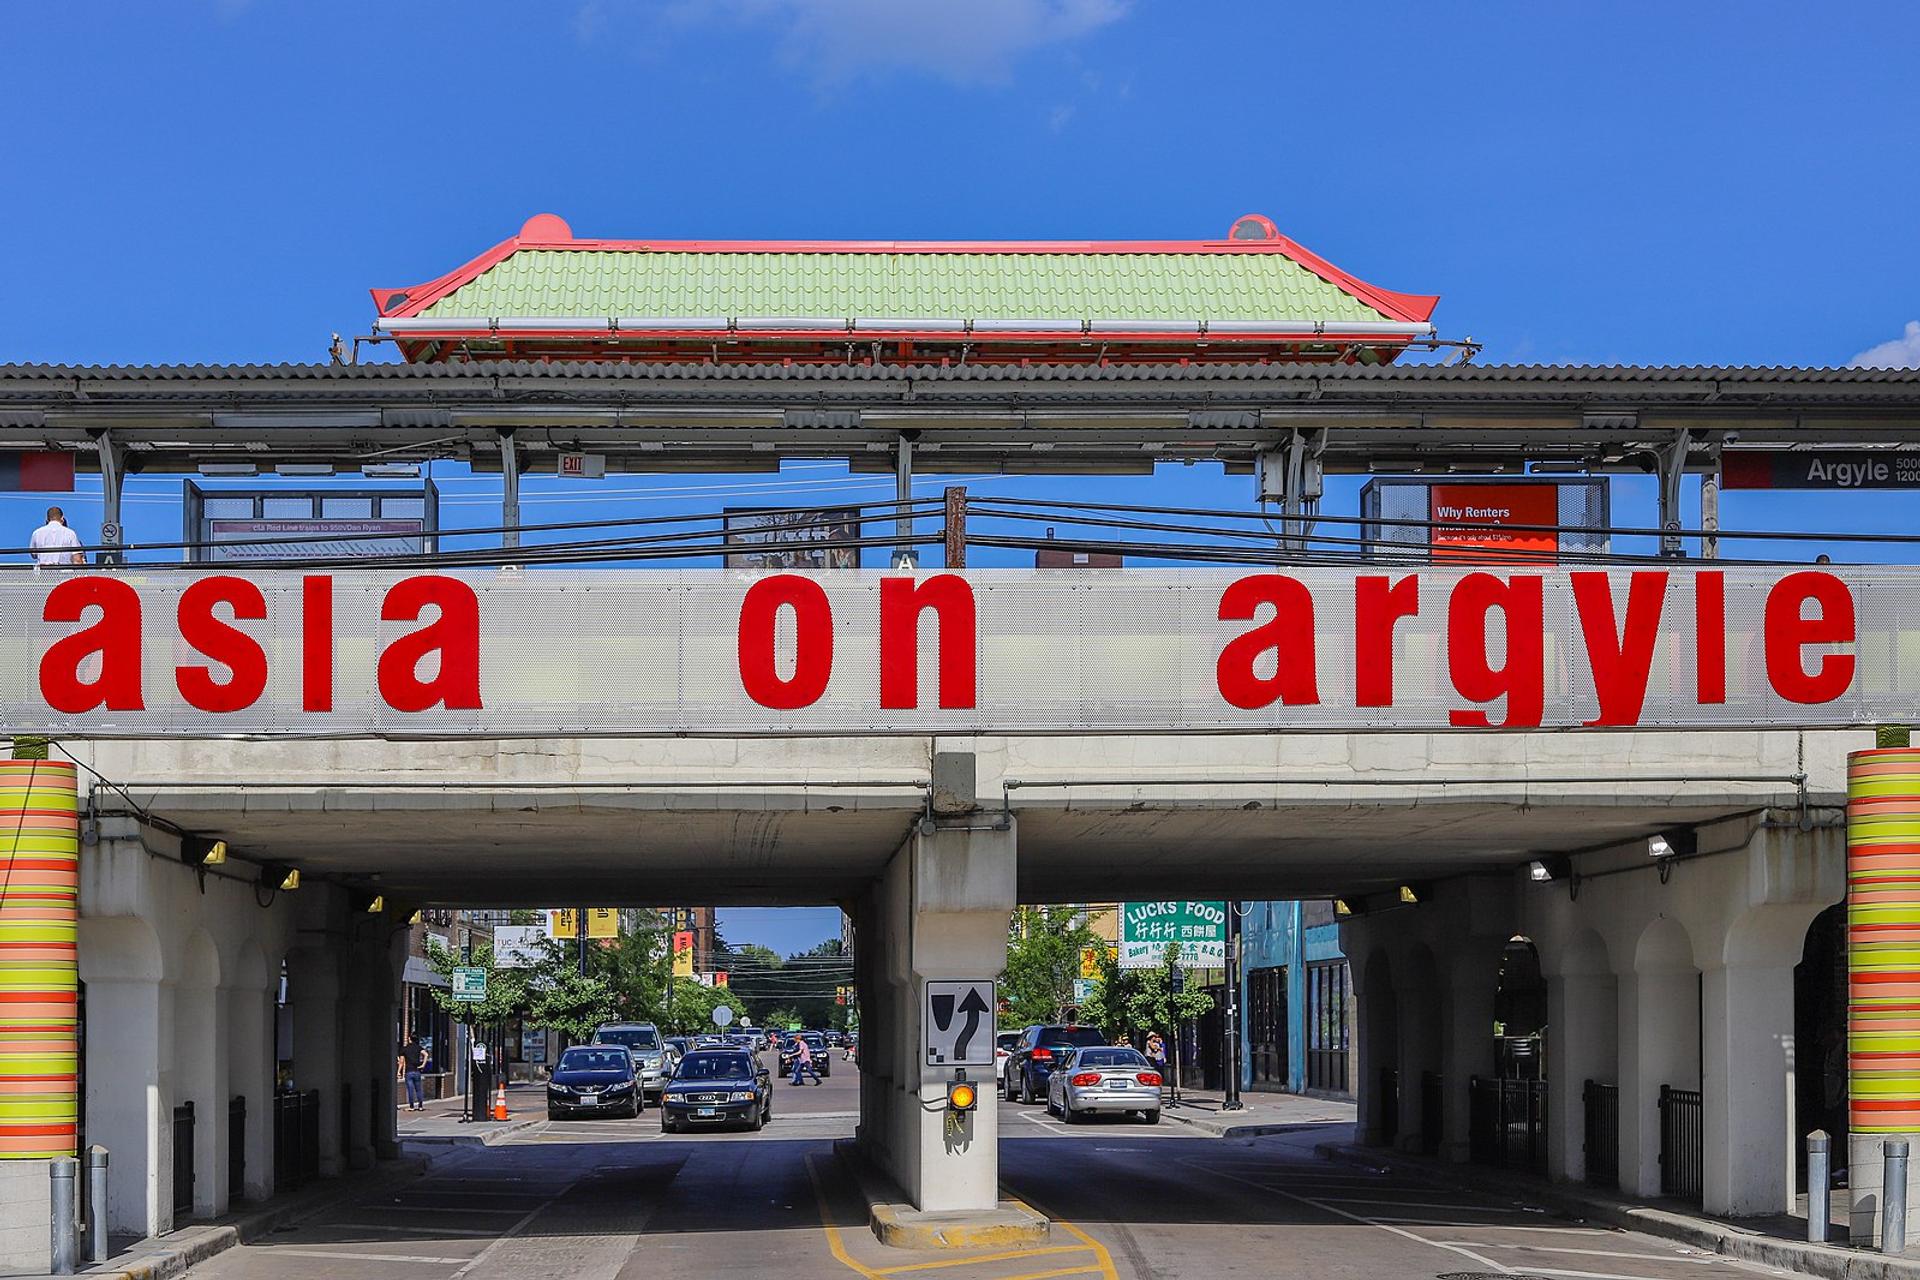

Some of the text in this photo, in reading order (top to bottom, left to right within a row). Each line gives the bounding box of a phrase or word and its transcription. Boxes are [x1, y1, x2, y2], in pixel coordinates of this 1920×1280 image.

[563, 456, 583, 471] EXIT
[1807, 458, 1889, 486] Argyle
[1437, 506, 1510, 519] Why Renters
[266, 524, 281, 532] Red
[282, 524, 299, 532] Line
[320, 524, 329, 532] to
[362, 524, 381, 533] Ryan
[737, 574, 977, 710] on
[1216, 571, 1855, 728] argyle
[1127, 901, 1225, 925] LUCKS FOOD
[1135, 922, 1176, 939] 行行行
[1127, 945, 1149, 958] Bakery
